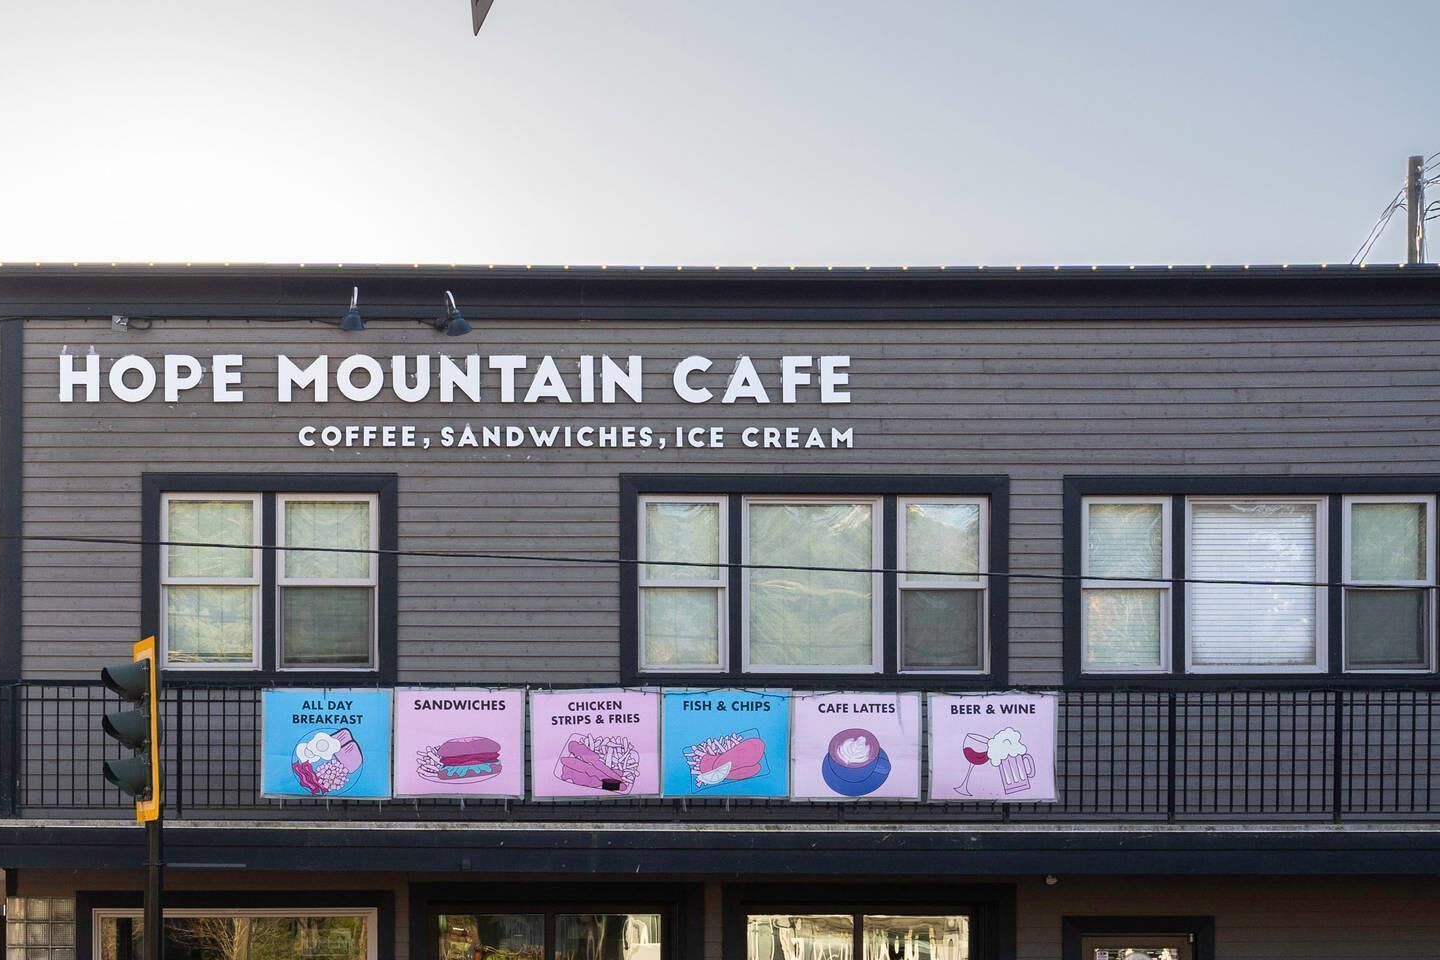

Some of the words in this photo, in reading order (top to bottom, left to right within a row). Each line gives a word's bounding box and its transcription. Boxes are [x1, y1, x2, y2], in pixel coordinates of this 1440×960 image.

[60, 353, 243, 402] HOPE
[277, 354, 643, 403] MOUNTAIN
[673, 355, 852, 403] CAFE
[676, 427, 724, 448] ICE
[741, 427, 854, 448] CREAM
[301, 700, 324, 711] ALL
[327, 700, 353, 711] DAY
[414, 699, 506, 711] SANDWICHES
[568, 700, 622, 711] CHICKEN
[683, 700, 712, 711] FISH
[716, 700, 727, 711] &
[731, 700, 771, 712] CHIPS
[818, 703, 849, 714] CAFE
[853, 703, 896, 714] LATTES
[950, 704, 981, 715] BEER
[985, 704, 995, 715] &
[1000, 703, 1036, 715] WINE
[292, 714, 363, 725] BREAKFAST
[551, 714, 592, 725] STRIPS
[595, 714, 605, 724] &
[608, 713, 641, 724] FRIES
